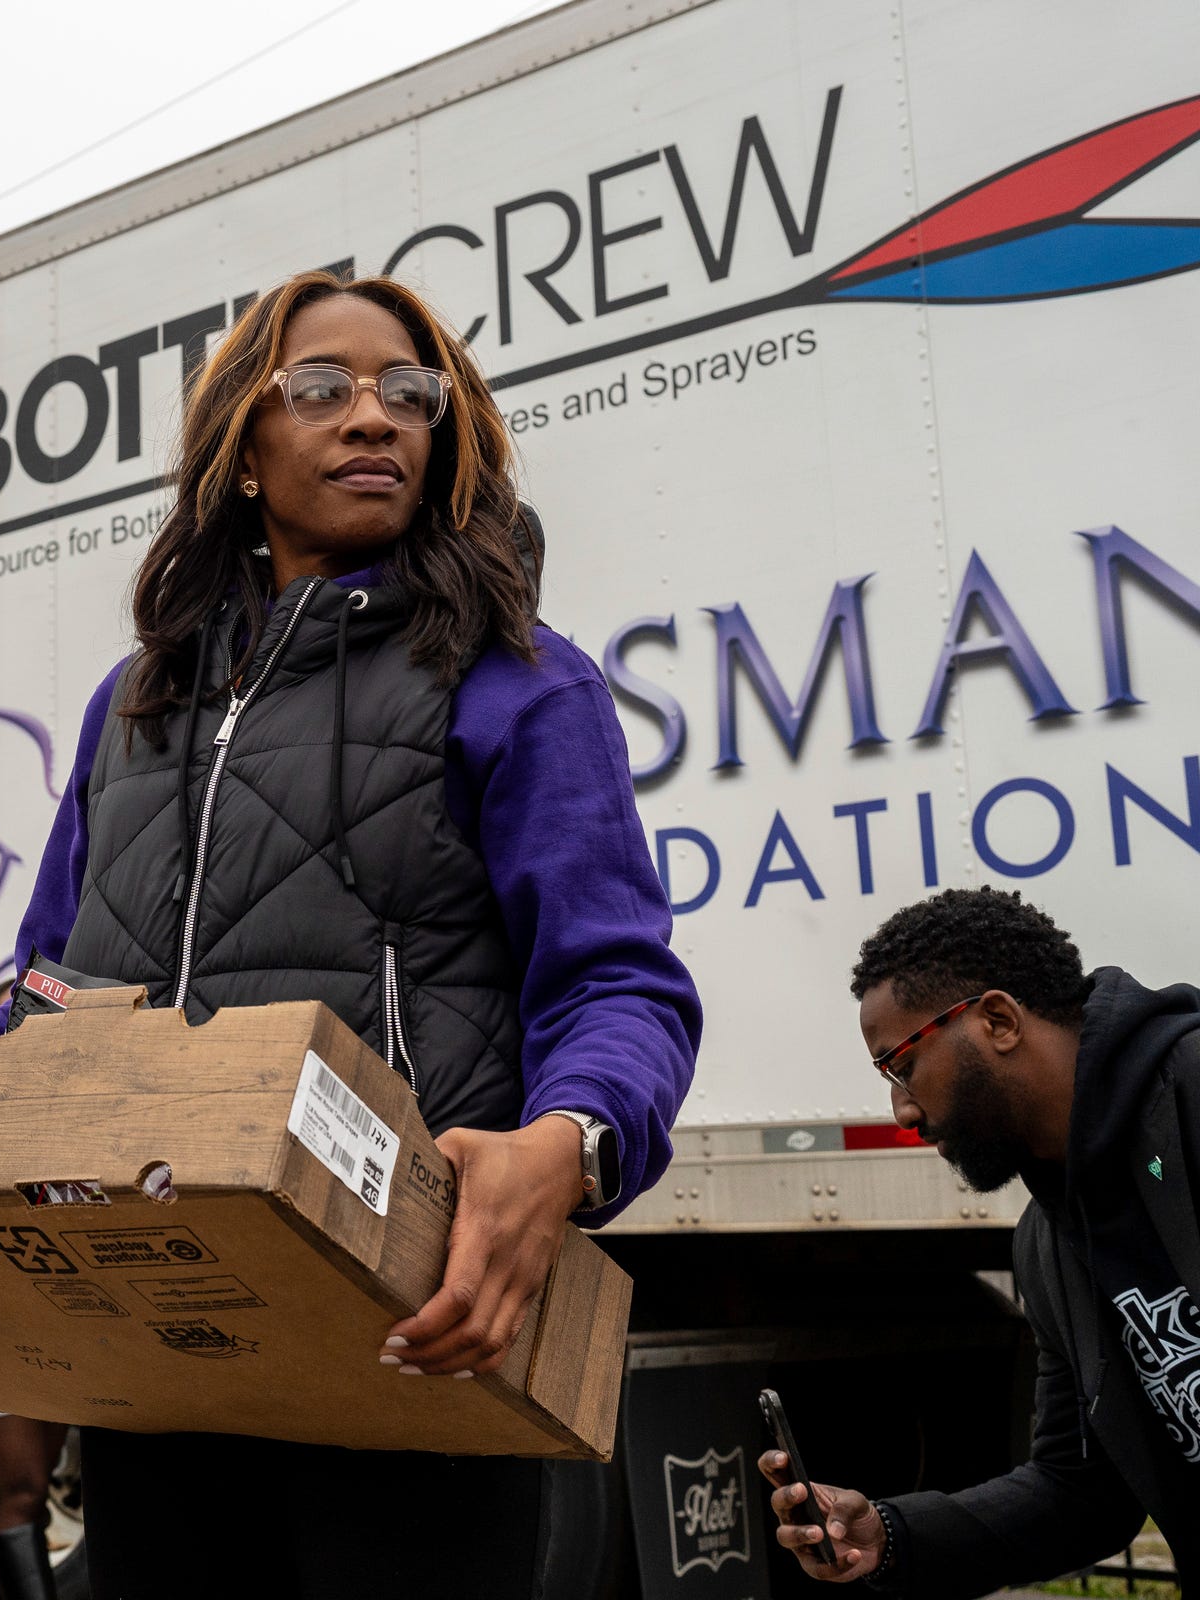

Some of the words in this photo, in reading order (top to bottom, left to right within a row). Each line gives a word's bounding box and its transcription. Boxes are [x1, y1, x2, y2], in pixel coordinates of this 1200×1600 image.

[381, 84, 844, 350] CREW
[68, 525, 102, 556] for
[562, 373, 628, 421] and
[642, 327, 817, 399] Sprayers
[603, 523, 1200, 785] SMAN
[655, 754, 1200, 917] DATION
[40, 978, 64, 999] PLU
[365, 1186, 379, 1205] 46
[410, 1151, 442, 1193] Four
